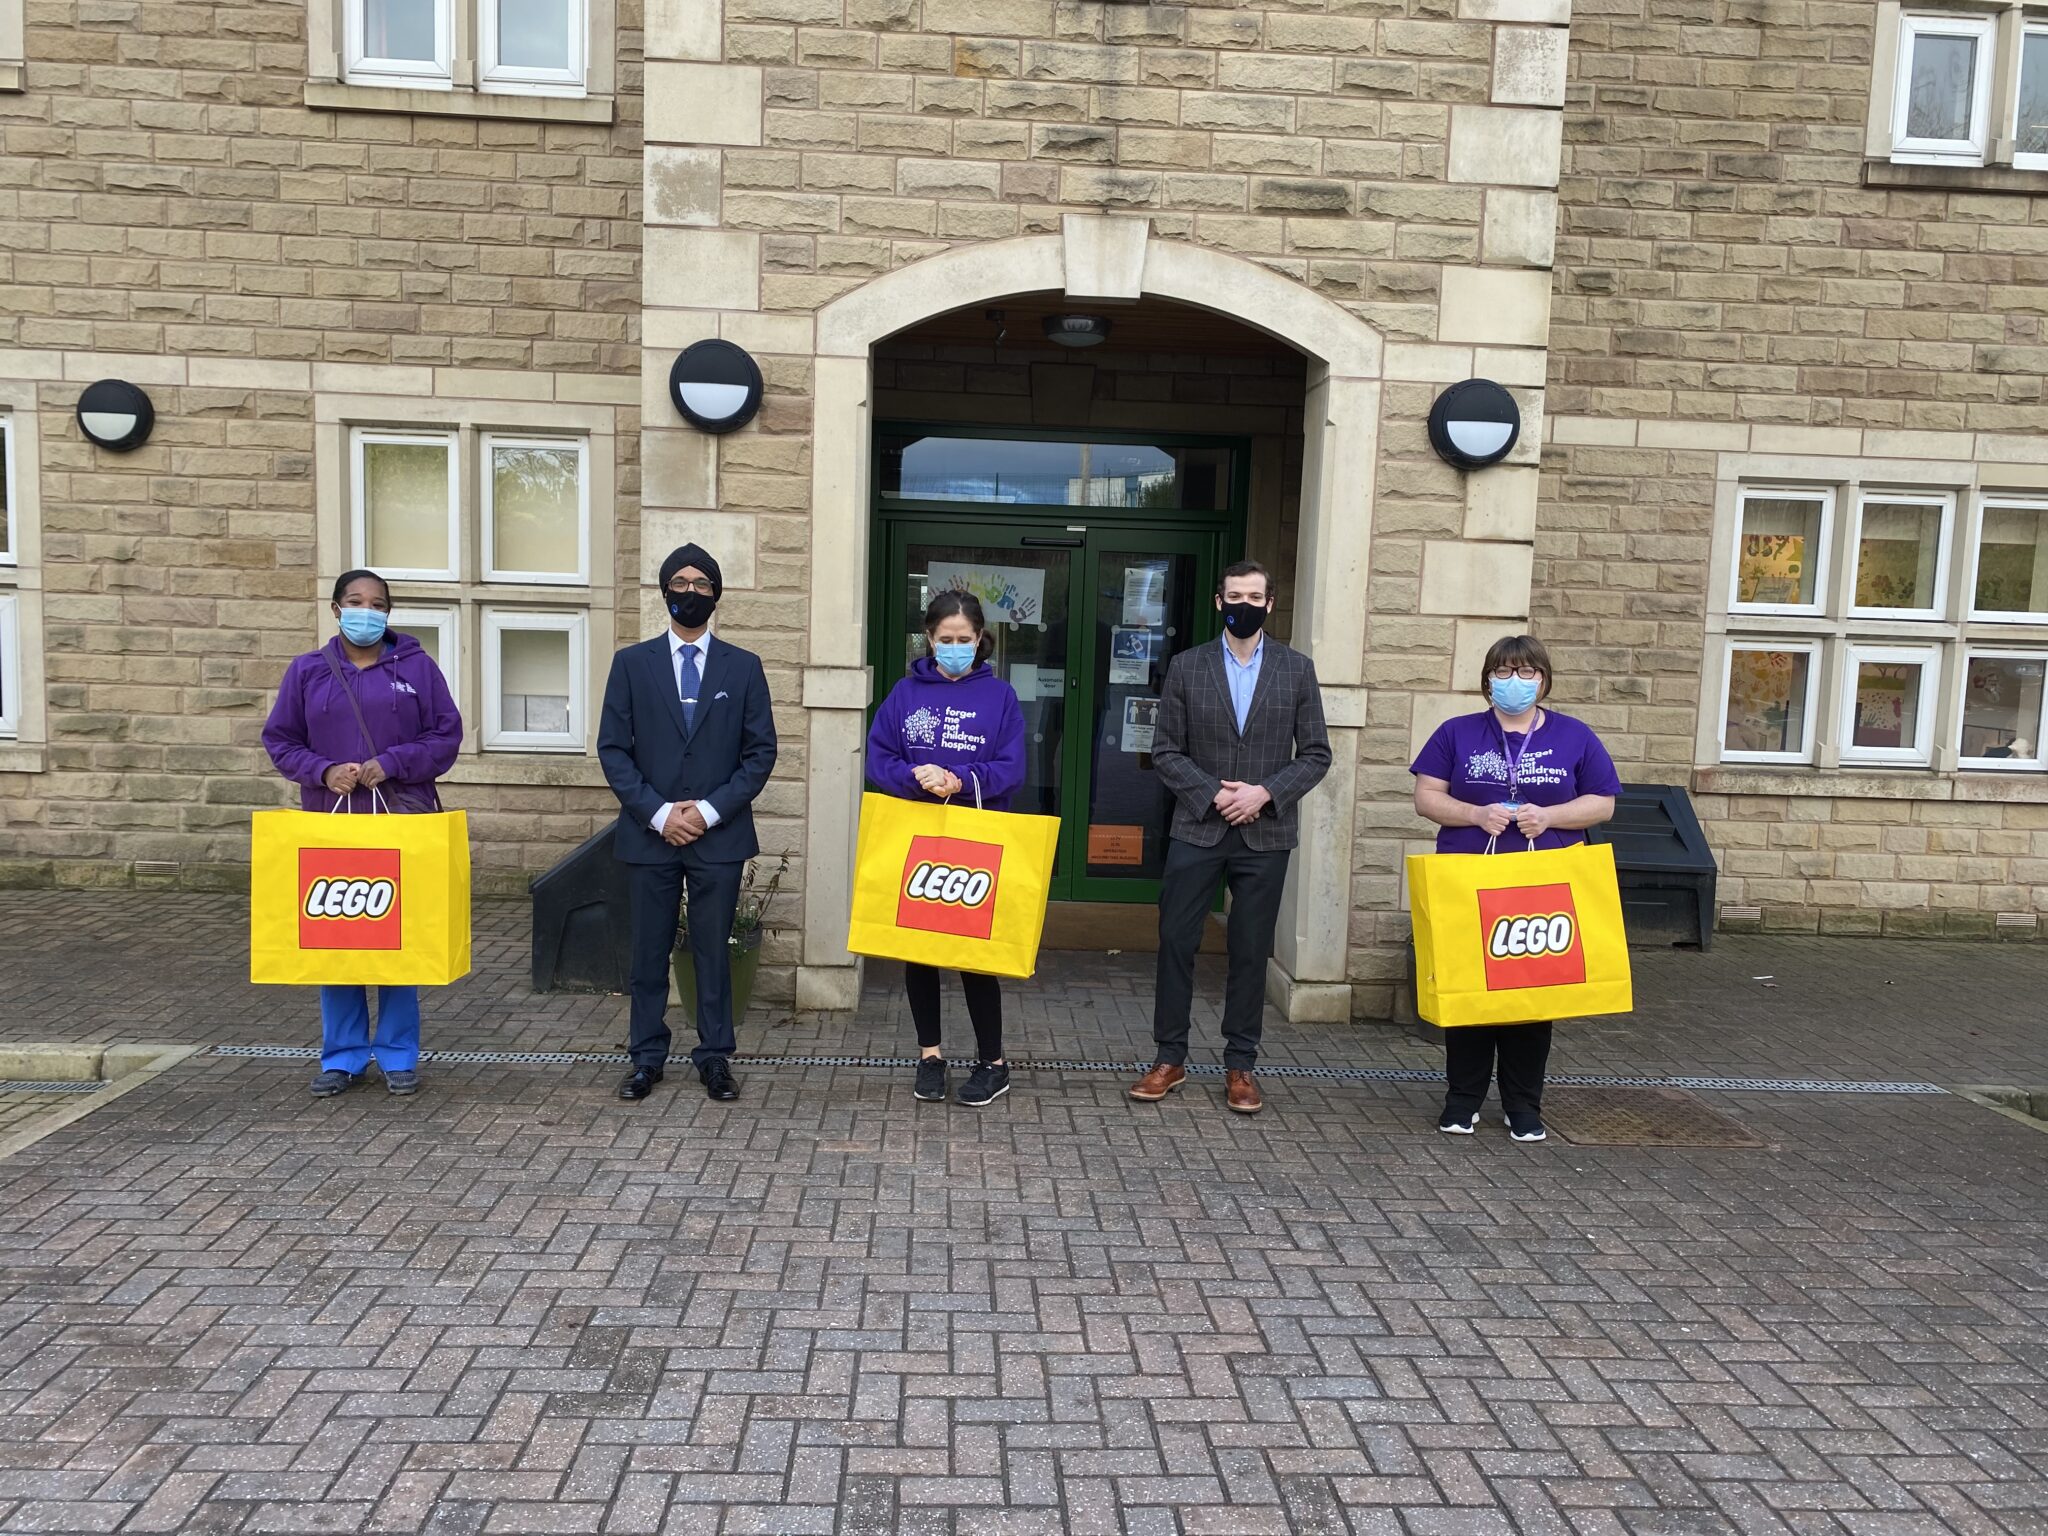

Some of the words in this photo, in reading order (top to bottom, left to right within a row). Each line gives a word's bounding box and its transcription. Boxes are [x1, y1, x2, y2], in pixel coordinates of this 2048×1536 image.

[945, 706, 977, 719] forget
[944, 716, 960, 724] me
[943, 723, 960, 731] not
[941, 731, 986, 744] children's
[941, 738, 977, 751] hospice
[1522, 749, 1553, 758] orget
[1517, 765, 1567, 777] children's
[1517, 774, 1560, 785] hospice
[905, 863, 992, 906] LEGO
[306, 879, 395, 918] LEGO
[1490, 914, 1573, 957] LEGO
